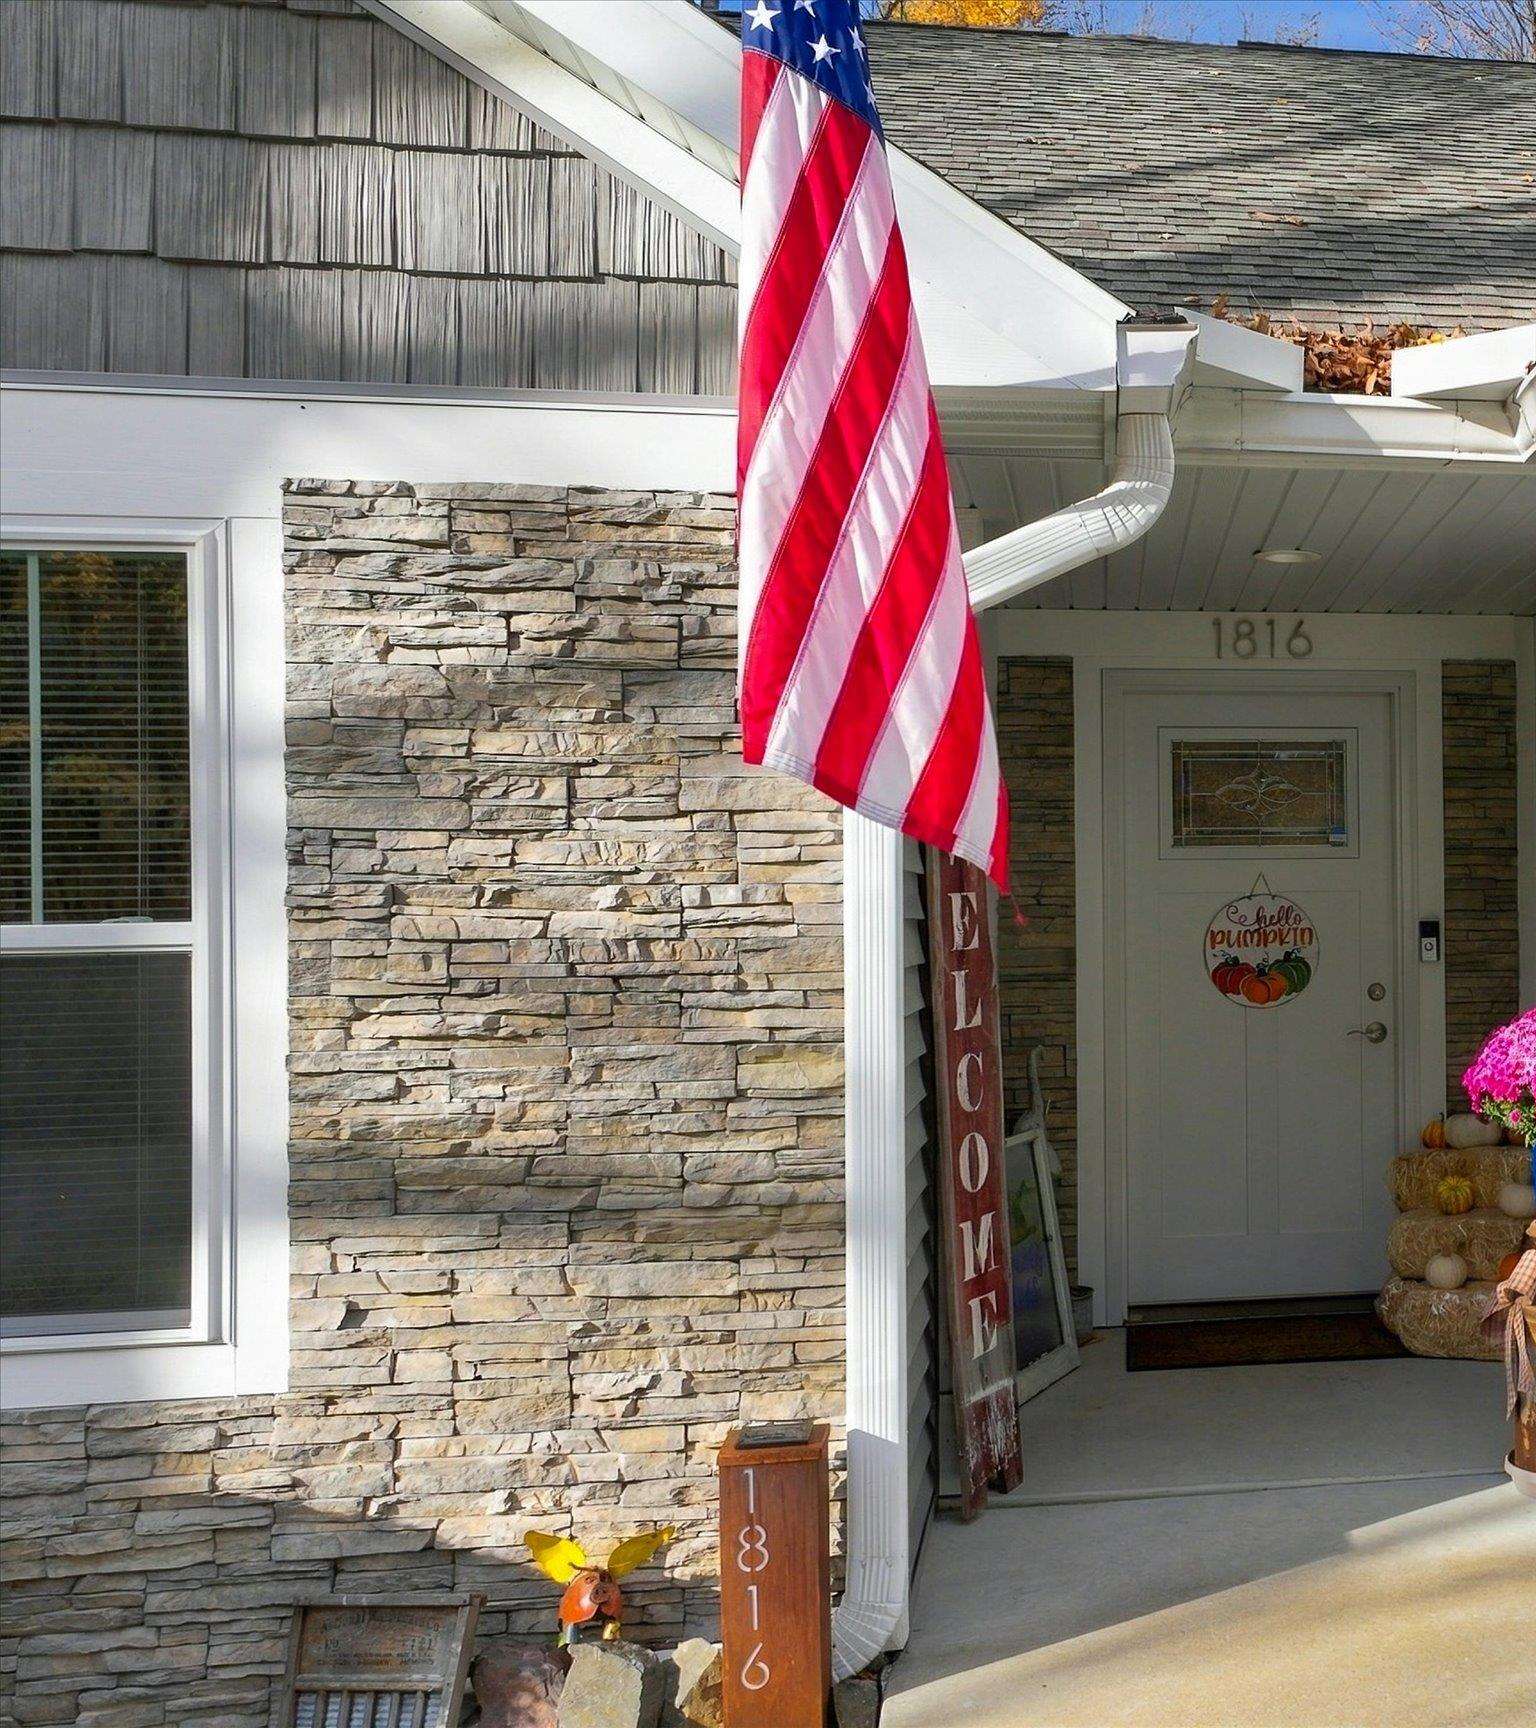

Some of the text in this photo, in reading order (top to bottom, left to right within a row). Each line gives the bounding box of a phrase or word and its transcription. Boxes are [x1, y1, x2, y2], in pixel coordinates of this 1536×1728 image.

[1212, 618, 1313, 660] 1816
[948, 853, 1000, 1361] ELCOME
[737, 1467, 771, 1691] 1816
